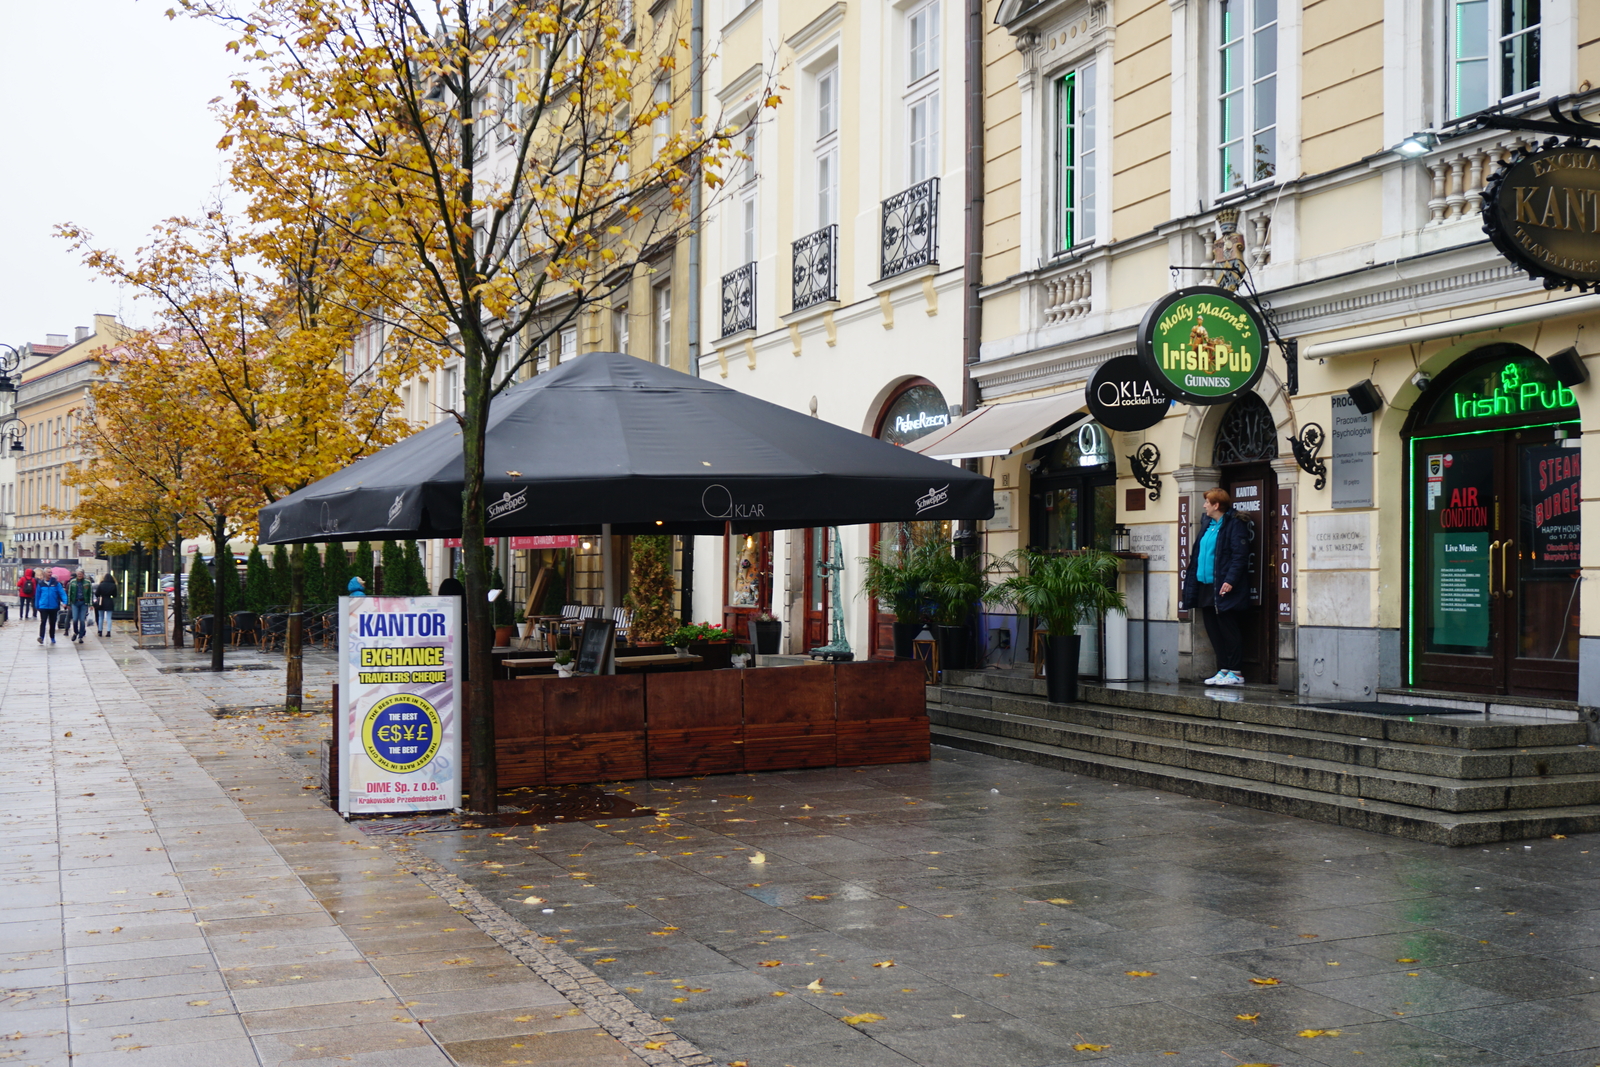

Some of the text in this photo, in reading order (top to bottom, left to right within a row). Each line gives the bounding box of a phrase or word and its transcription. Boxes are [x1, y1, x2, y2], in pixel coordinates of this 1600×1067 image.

[1515, 225, 1599, 273] TRAVELLERS
[1160, 302, 1251, 338] Molly Malone's
[1162, 342, 1252, 372] Irish Pub
[1184, 374, 1230, 388] GUINNESS
[1121, 396, 1166, 406] cocktail bar
[1454, 380, 1577, 419] Irish Pub
[1336, 415, 1368, 426] Pracownia
[1332, 427, 1372, 439] Psychologów
[1538, 452, 1581, 492] STEAK
[1236, 486, 1258, 498] KANTOR
[1450, 486, 1478, 508] AIR
[488, 494, 526, 518] Schweppes
[917, 491, 948, 510] Schweppes
[1535, 479, 1582, 528] BURGE
[1440, 506, 1488, 528] CONDITION
[1316, 533, 1331, 541] CECH
[1542, 526, 1561, 534] HAPPY
[1281, 504, 1290, 589] KANTOR
[1444, 544, 1478, 552] Live Music
[1280, 602, 1290, 612] 0%
[359, 612, 446, 637] KANTOR
[361, 646, 444, 667] EXCHANGE
[359, 670, 446, 684] TRAVELERS CHEQUE
[368, 711, 377, 721] THE
[379, 698, 393, 710] BEST
[419, 702, 430, 713] THE
[428, 711, 438, 724] CITY
[388, 712, 418, 721] THE BEST
[368, 745, 378, 759] CITY
[388, 746, 418, 754] THE BEST
[430, 742, 438, 754] THE
[378, 759, 389, 767] THE
[416, 752, 430, 766] BEST
[366, 782, 391, 793] DIME
[394, 782, 410, 794] Sp.
[413, 783, 419, 792] z
[396, 795, 437, 804] Przedmieście
